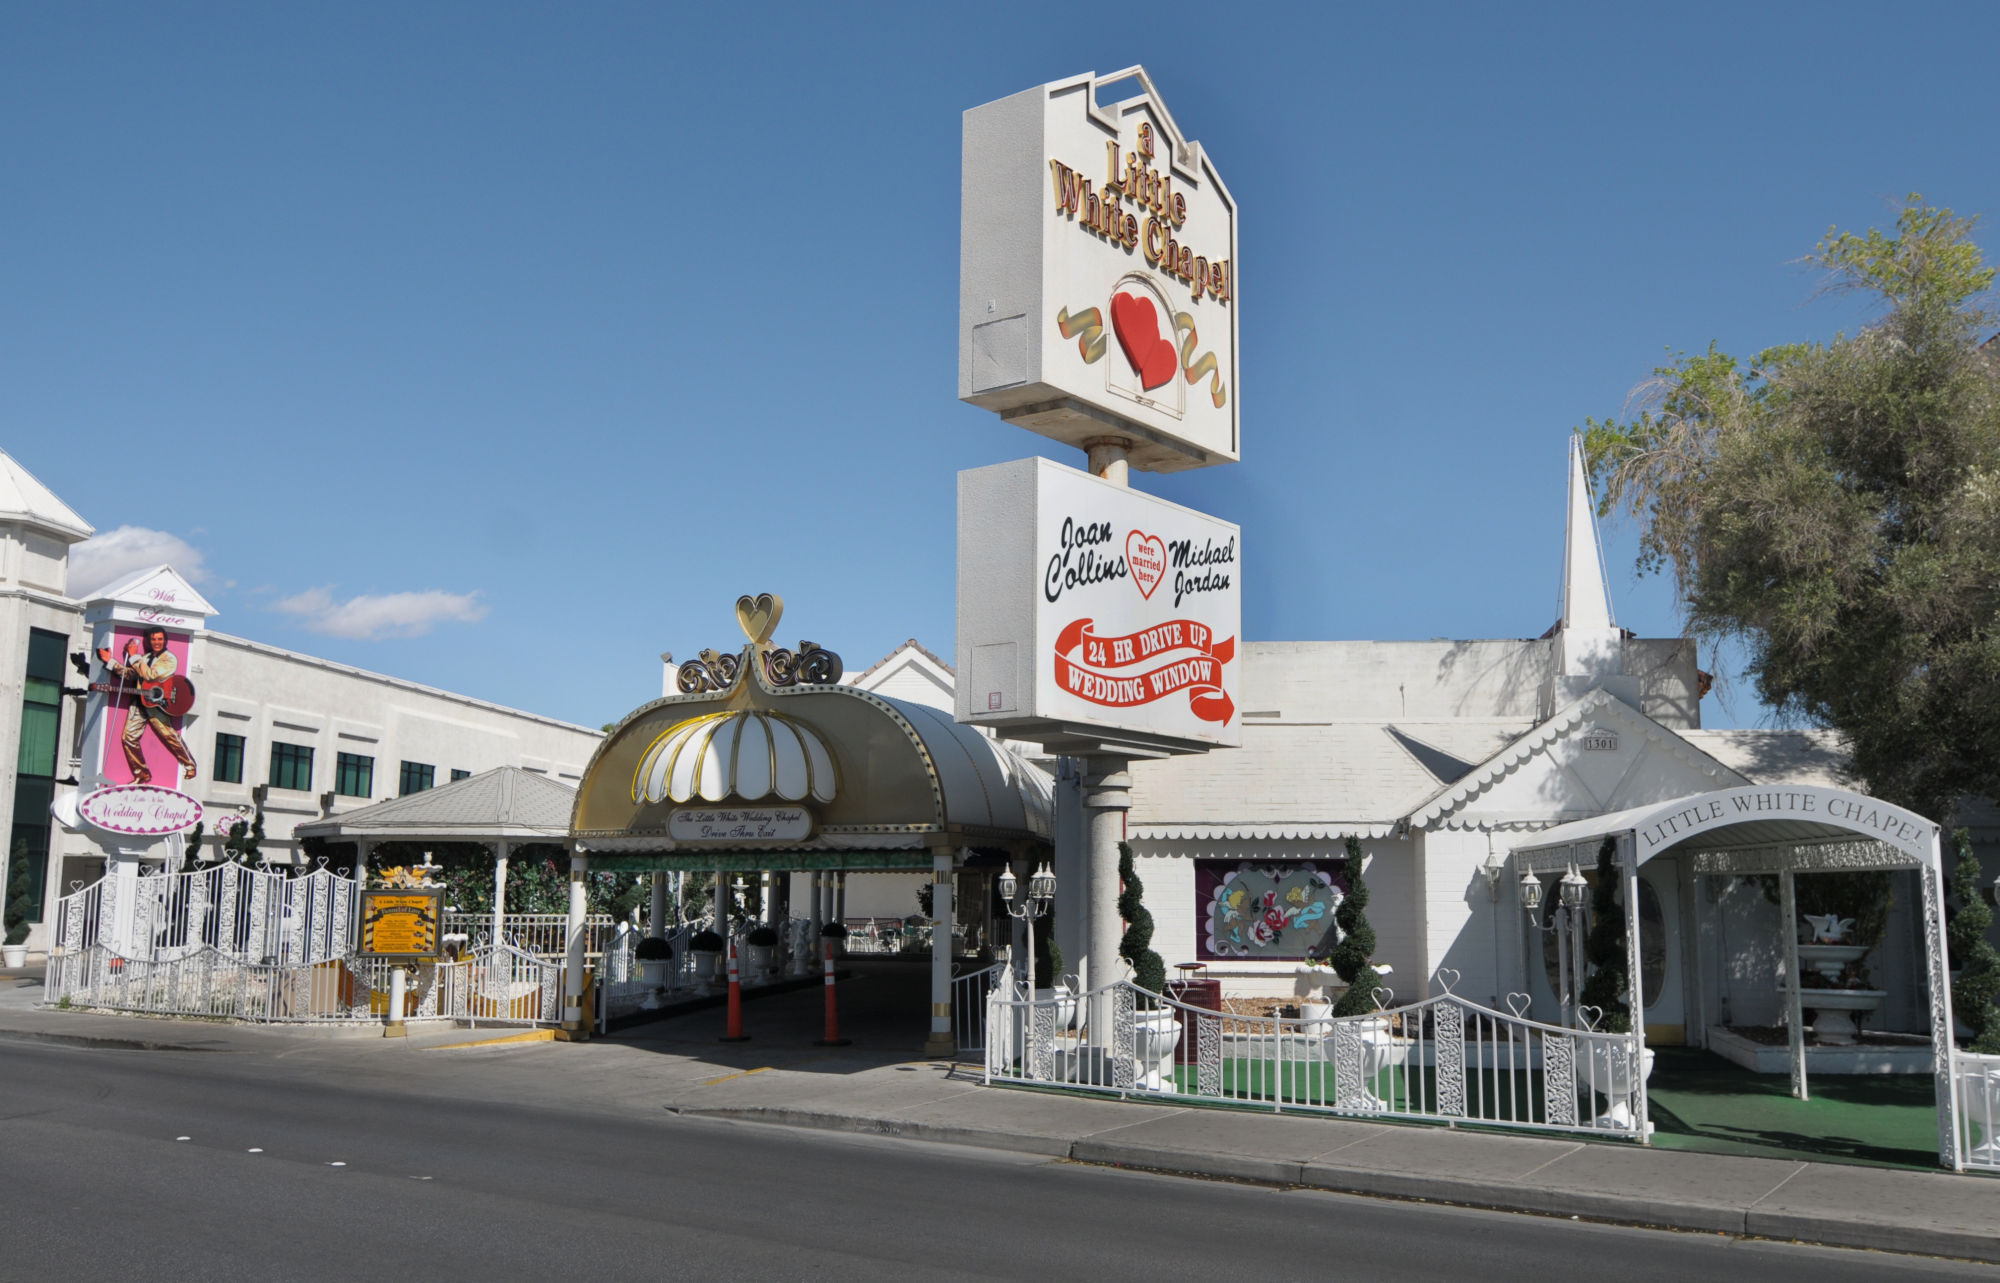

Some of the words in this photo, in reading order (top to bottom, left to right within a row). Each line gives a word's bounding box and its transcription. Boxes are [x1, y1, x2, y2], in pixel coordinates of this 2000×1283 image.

[1137, 122, 1155, 159] a
[1106, 140, 1187, 226] Little
[1049, 159, 1139, 249] White
[1142, 216, 1231, 301] Chapel
[1061, 516, 1112, 568] Joan
[1138, 543, 1155, 557] were
[1168, 535, 1235, 569] Michael
[1045, 549, 1128, 603] Collins
[1132, 555, 1161, 573] married
[1138, 569, 1155, 584] here
[148, 588, 177, 602] With
[1174, 567, 1230, 608] Jordan
[135, 606, 185, 624] Love
[1089, 641, 1106, 666] 24
[1113, 638, 1135, 664] HR
[1140, 623, 1183, 656] DRIVE
[1190, 624, 1208, 648] UP
[1068, 664, 1145, 704] WEDDING
[1149, 660, 1213, 695] WINDOW
[1588, 739, 1612, 749] 1301
[91, 801, 143, 821] Wedding
[148, 803, 188, 823] Chapel
[695, 812, 715, 822] Little
[717, 811, 738, 822] White
[740, 811, 772, 825] Wedding
[775, 810, 802, 824] Chapel
[1642, 800, 1725, 847] LITTLE
[1731, 792, 1817, 814] WHITE
[1827, 798, 1924, 850] CHAPEL
[701, 825, 727, 838] Drive
[729, 825, 754, 838] Thru
[757, 825, 776, 838] Exit
